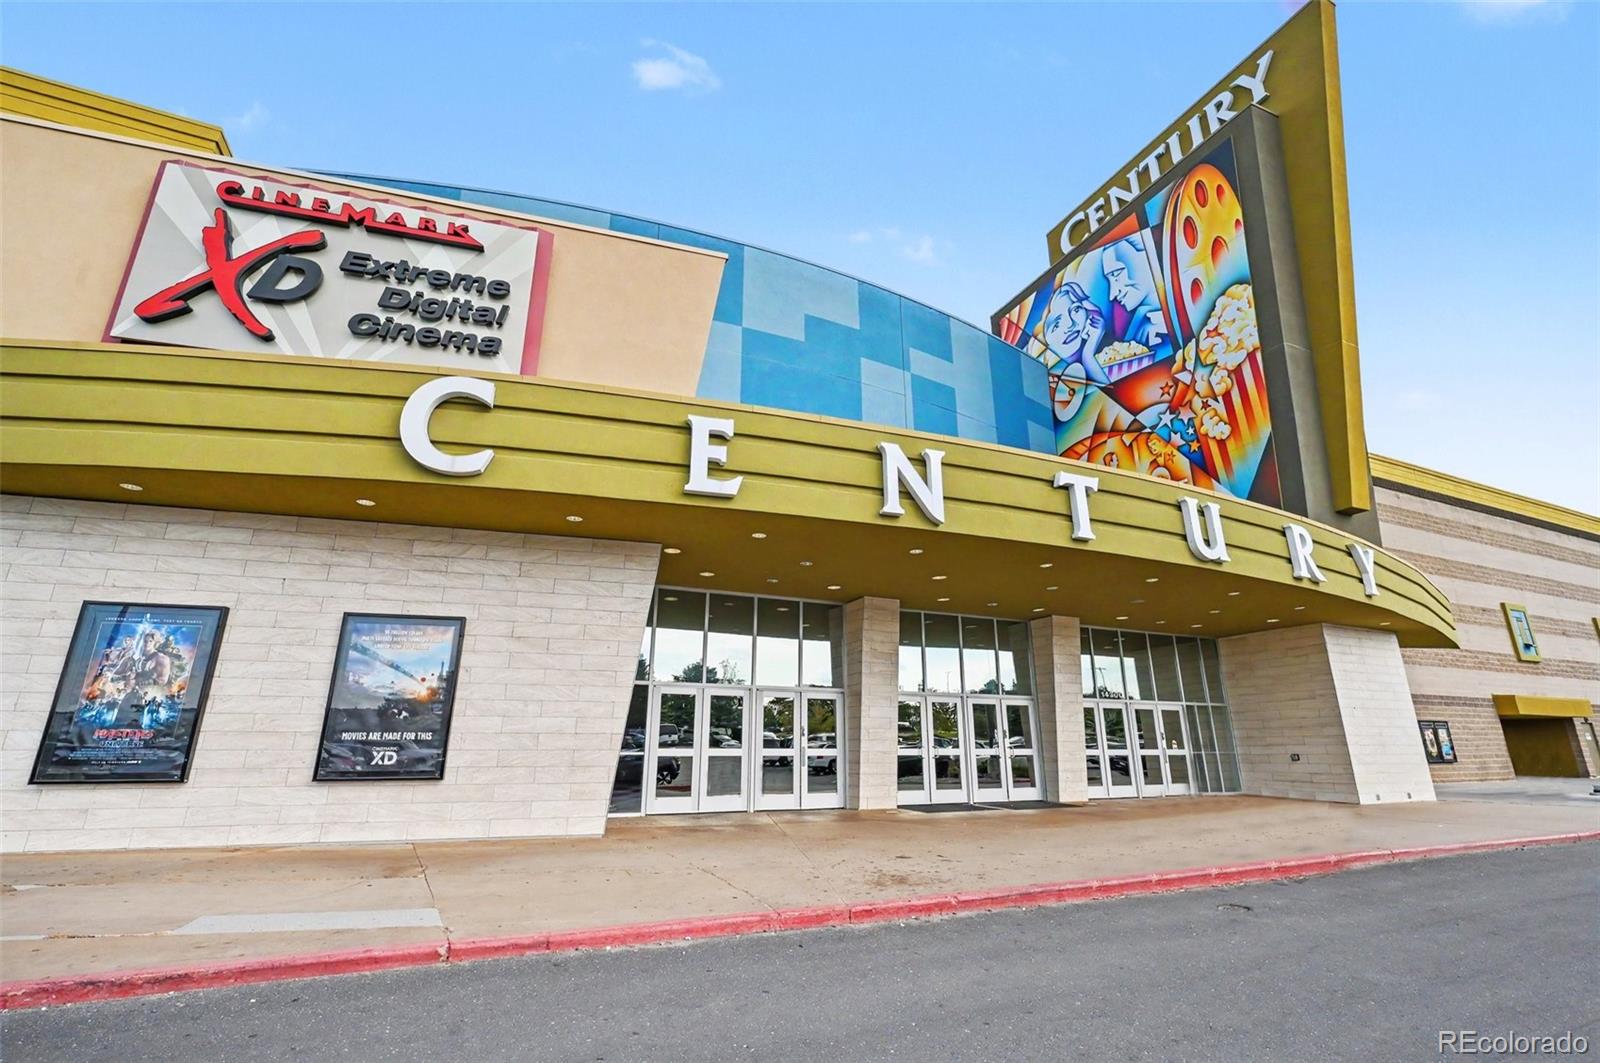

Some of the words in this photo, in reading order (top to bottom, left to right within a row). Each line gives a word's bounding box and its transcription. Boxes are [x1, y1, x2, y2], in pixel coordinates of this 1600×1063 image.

[1059, 48, 1275, 257] CENTURY
[216, 180, 480, 248] CINEMARK
[133, 206, 328, 342] XD
[339, 250, 511, 299] Extreme
[378, 286, 510, 328] Digital
[348, 312, 503, 357] Cinema
[398, 375, 1380, 598] CENTURY
[341, 731, 367, 741] MOVIES
[368, 731, 381, 741] ARE
[382, 731, 401, 741] MADE
[402, 731, 416, 741] FOR
[417, 732, 433, 740] THIS
[370, 751, 398, 766] XD
